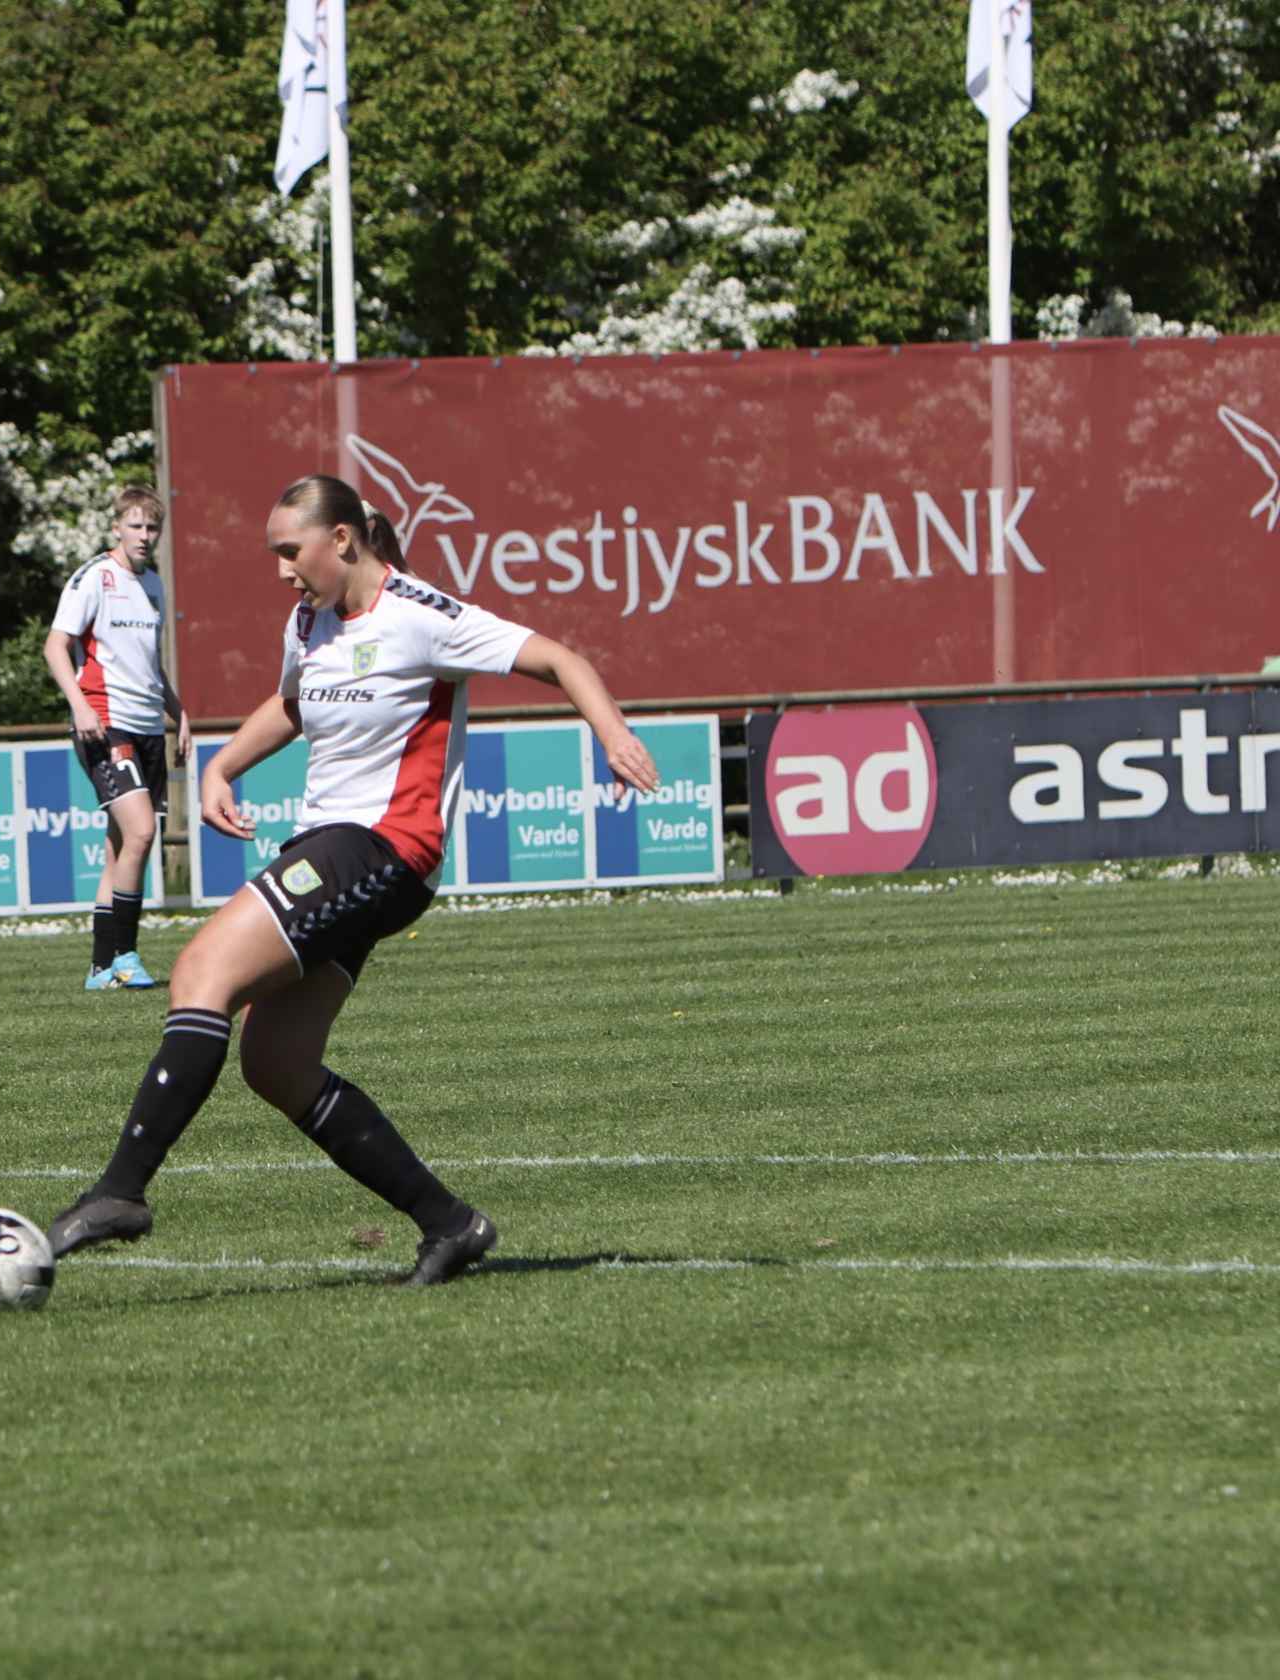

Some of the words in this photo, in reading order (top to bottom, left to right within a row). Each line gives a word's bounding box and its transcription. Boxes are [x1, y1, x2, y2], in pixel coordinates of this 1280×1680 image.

[435, 486, 1045, 617] vestjyskBANK
[300, 687, 376, 702] ECHERS
[775, 721, 929, 836] ad
[464, 785, 585, 818] Nybolig
[21, 806, 108, 836] Nybo
[518, 822, 579, 847] Varde
[647, 817, 708, 841] Varde
